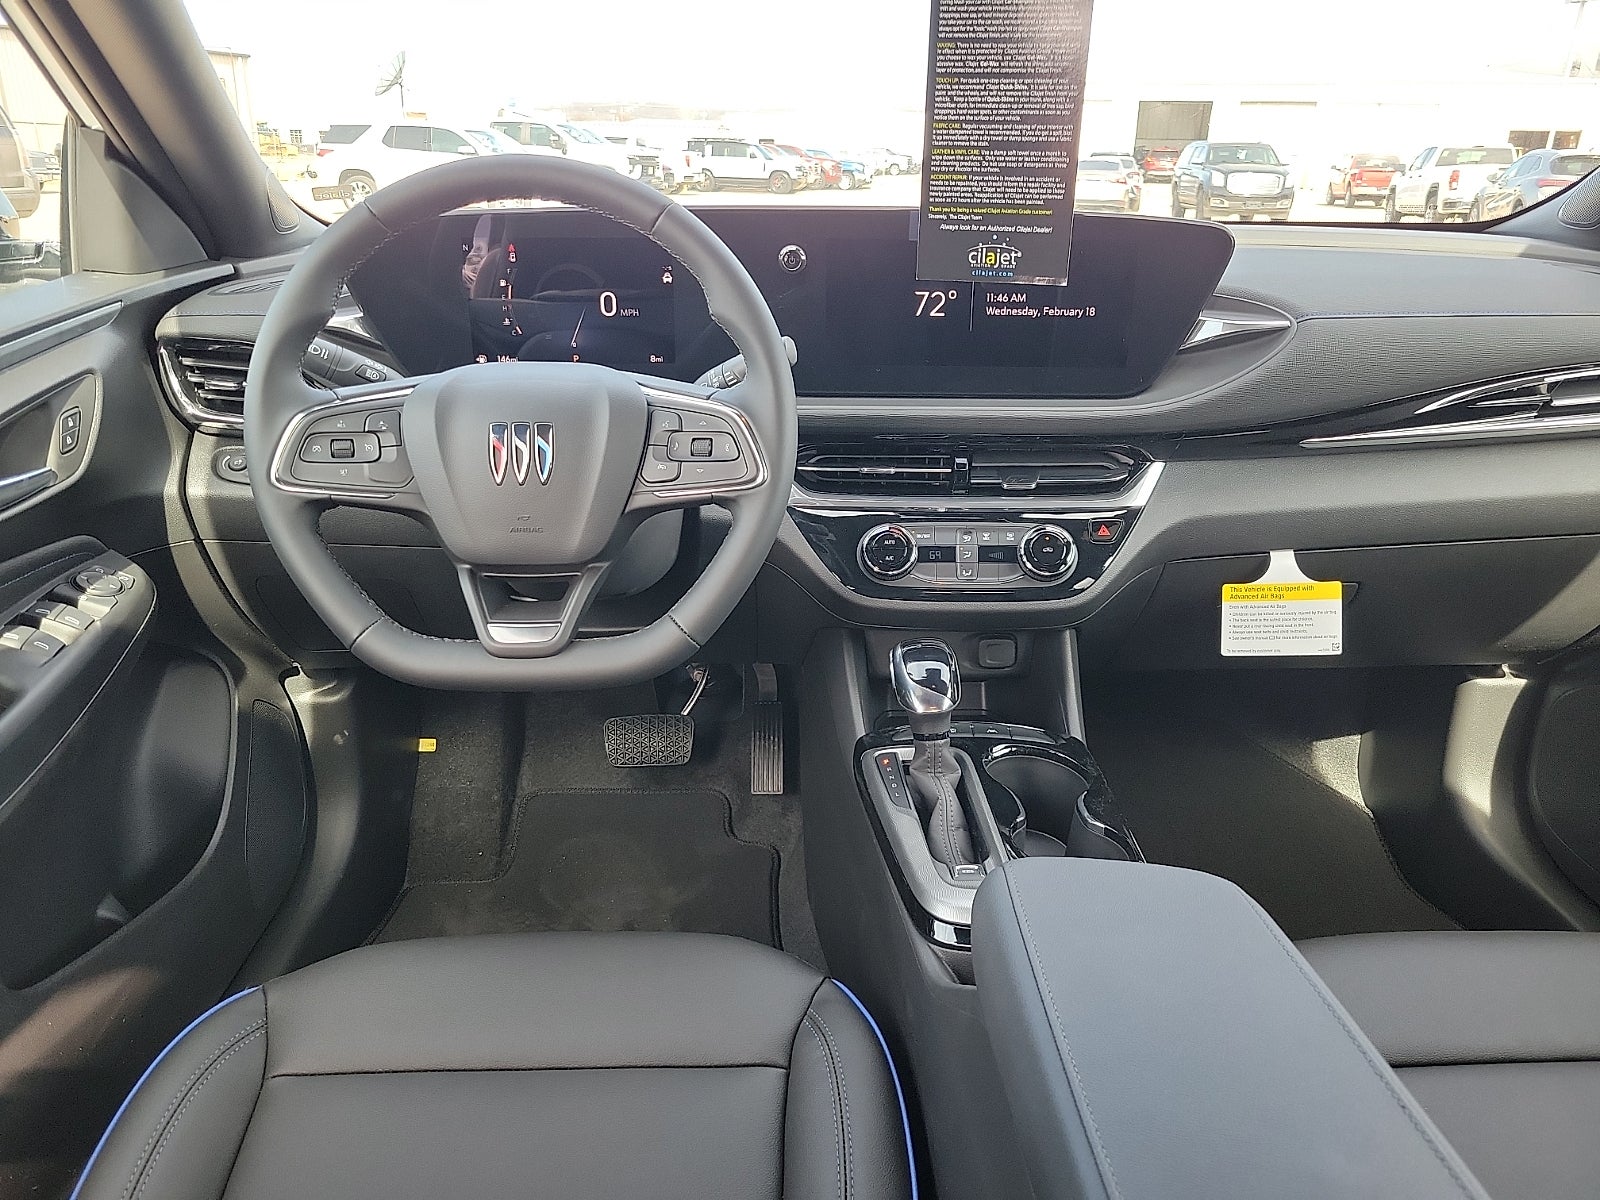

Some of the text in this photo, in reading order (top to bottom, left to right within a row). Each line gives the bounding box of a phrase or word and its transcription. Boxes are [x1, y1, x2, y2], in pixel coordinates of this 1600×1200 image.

[940, 224, 959, 232] Always
[1016, 226, 1032, 234] Cilajet
[968, 248, 1017, 268] cilajet
[915, 290, 957, 317] 72°
[986, 293, 1026, 302] 11:46 AM
[600, 291, 640, 317] 0 MPH
[986, 306, 1095, 318] Wednesday, February 18
[929, 551, 941, 560] 69
